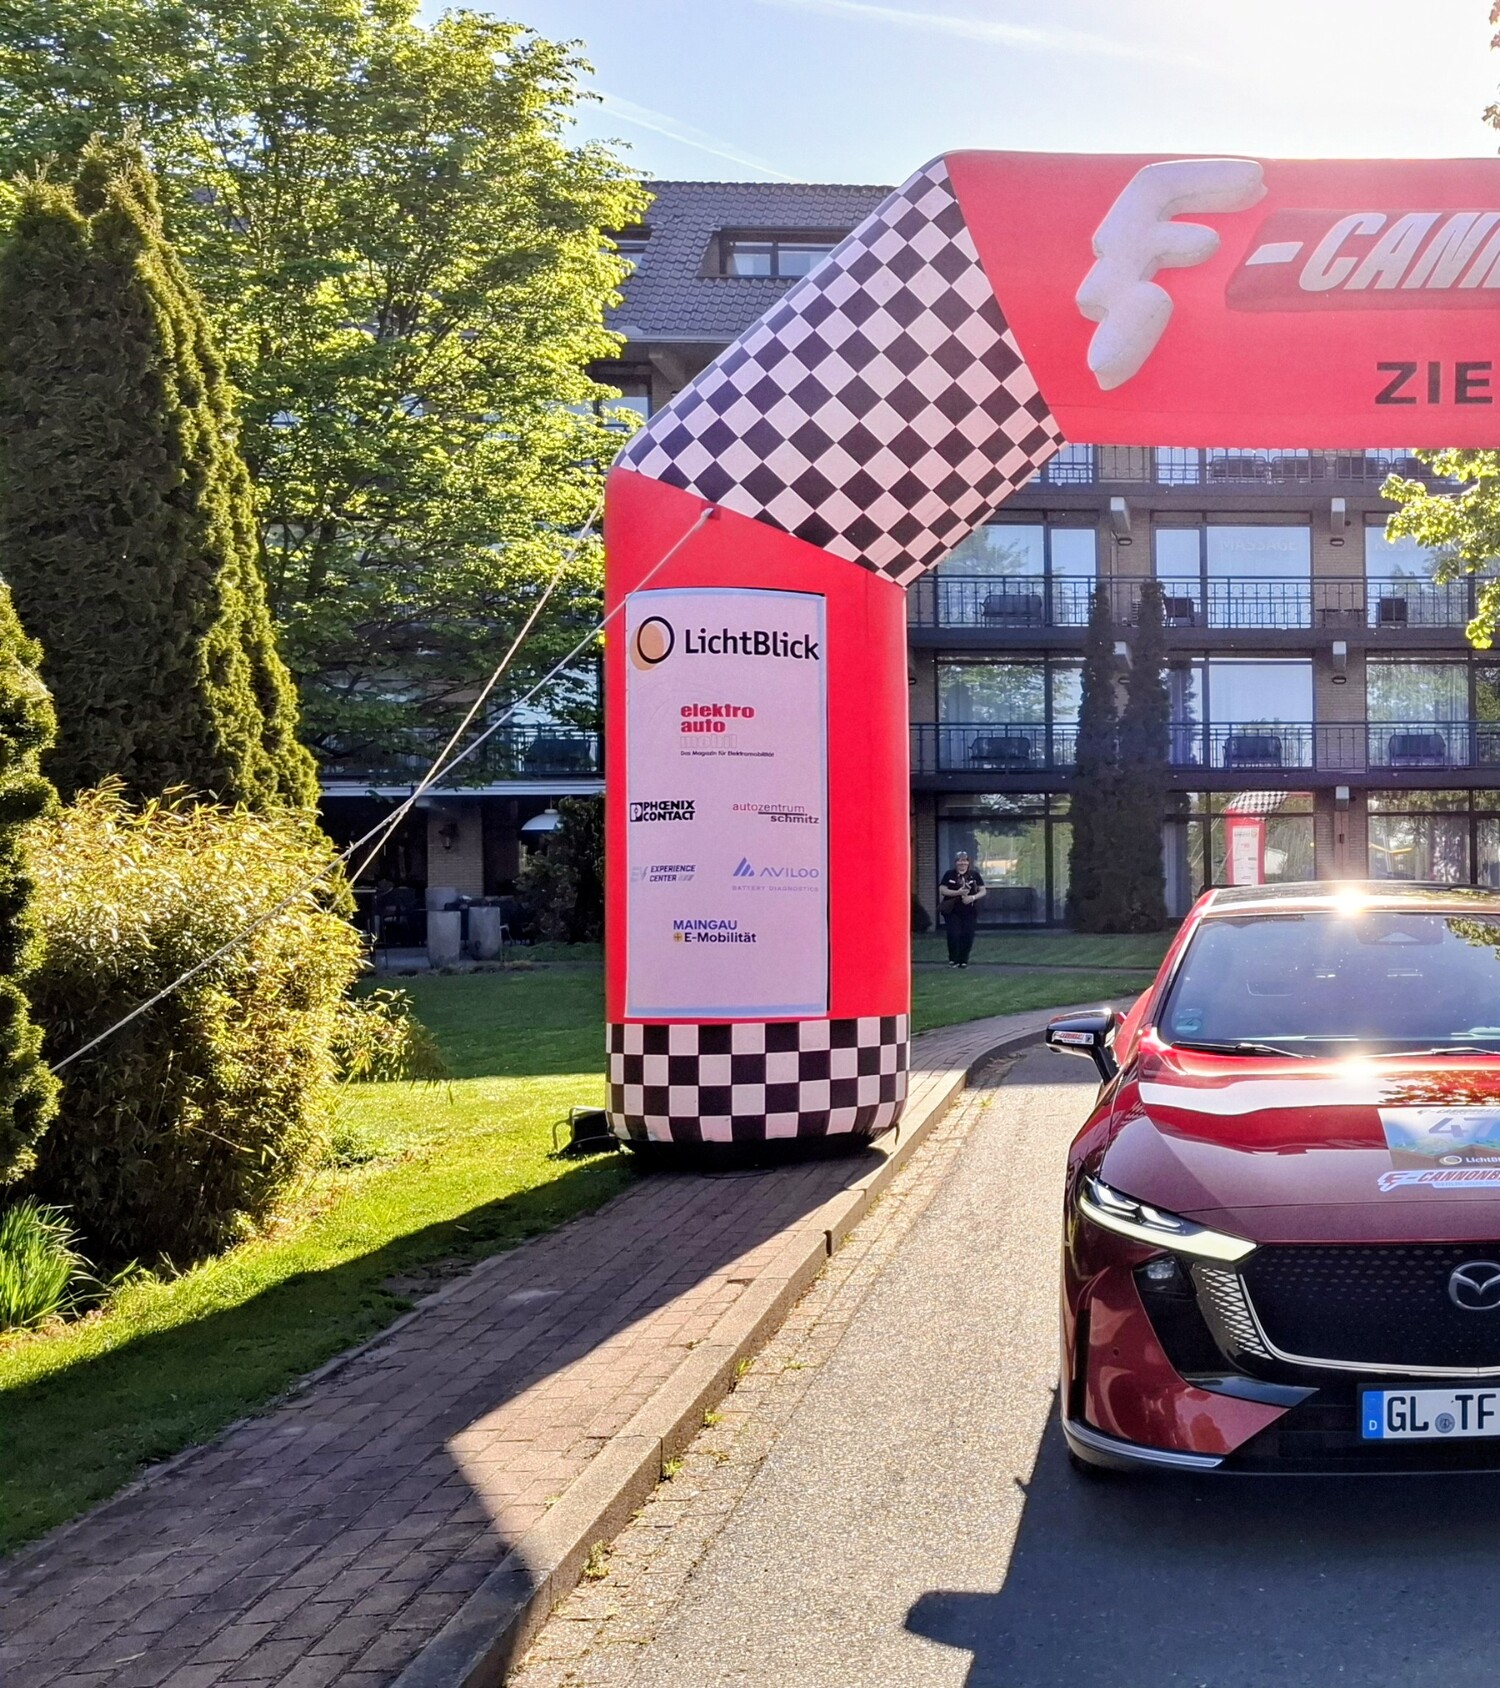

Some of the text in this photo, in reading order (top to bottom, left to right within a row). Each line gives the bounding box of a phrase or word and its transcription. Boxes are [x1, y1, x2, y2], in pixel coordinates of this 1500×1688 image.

[1220, 537, 1297, 552] MASSAGE
[684, 627, 820, 661] LichtBlick
[680, 703, 755, 718] elektro
[680, 718, 727, 733] auto
[732, 802, 805, 813] autozentrum
[643, 810, 696, 822] CONTACT
[770, 813, 820, 825] schmitz
[650, 864, 696, 873] EXPERIENCE
[759, 866, 820, 879] AVILOO
[649, 874, 677, 882] CENTER
[673, 919, 738, 931] MAINGAU
[684, 931, 757, 944] E-Mobilität
[1428, 1117, 1499, 1138] 47
[1386, 1395, 1430, 1433] GL
[1368, 1419, 1378, 1431] D
